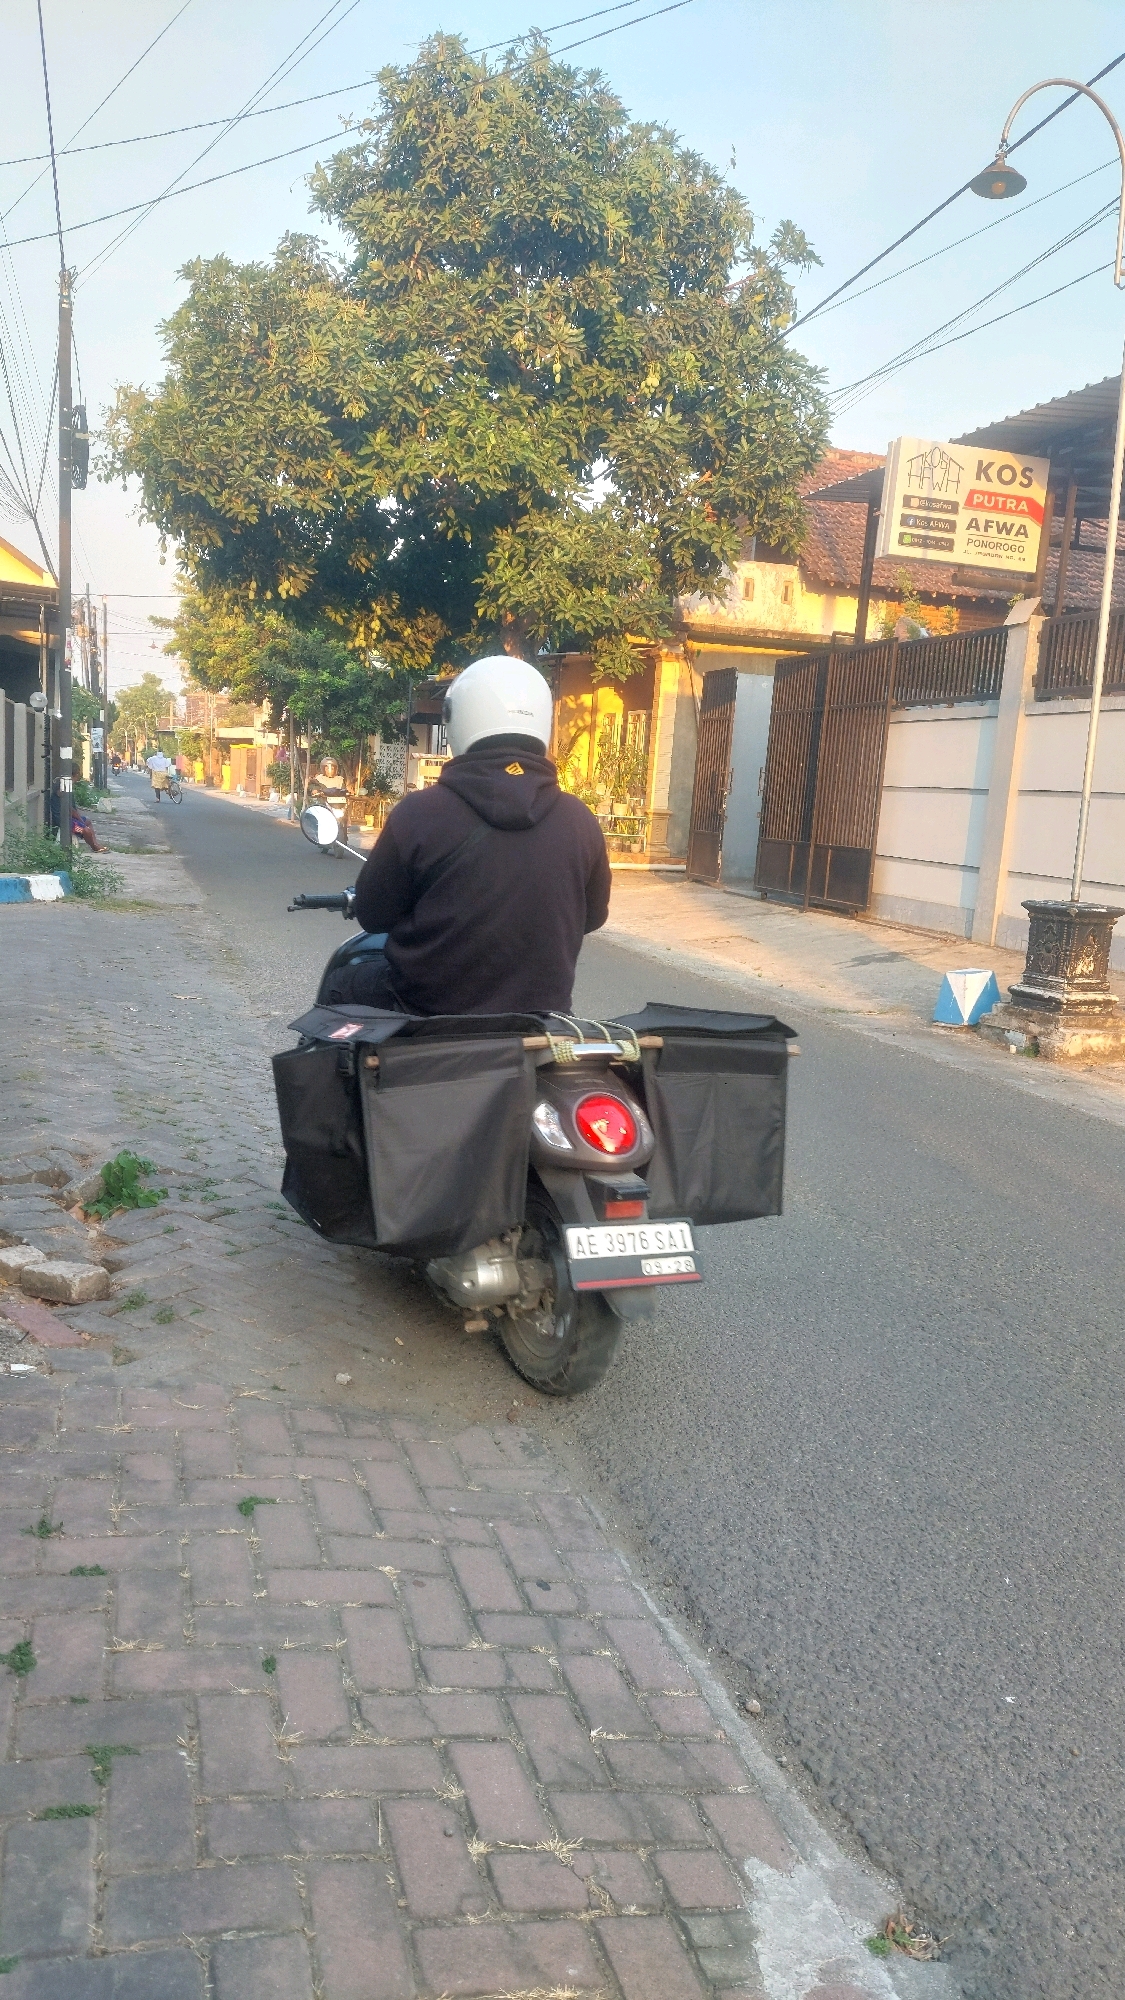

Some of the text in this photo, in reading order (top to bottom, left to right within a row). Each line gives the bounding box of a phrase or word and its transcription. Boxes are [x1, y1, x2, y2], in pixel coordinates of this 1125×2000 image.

[975, 459, 1034, 489] KOS
[973, 493, 1029, 513] PUTRA
[965, 517, 1029, 538] AFWA
[966, 538, 1025, 554] PONOROGO
[576, 1228, 688, 1256] AE 3976 SAI
